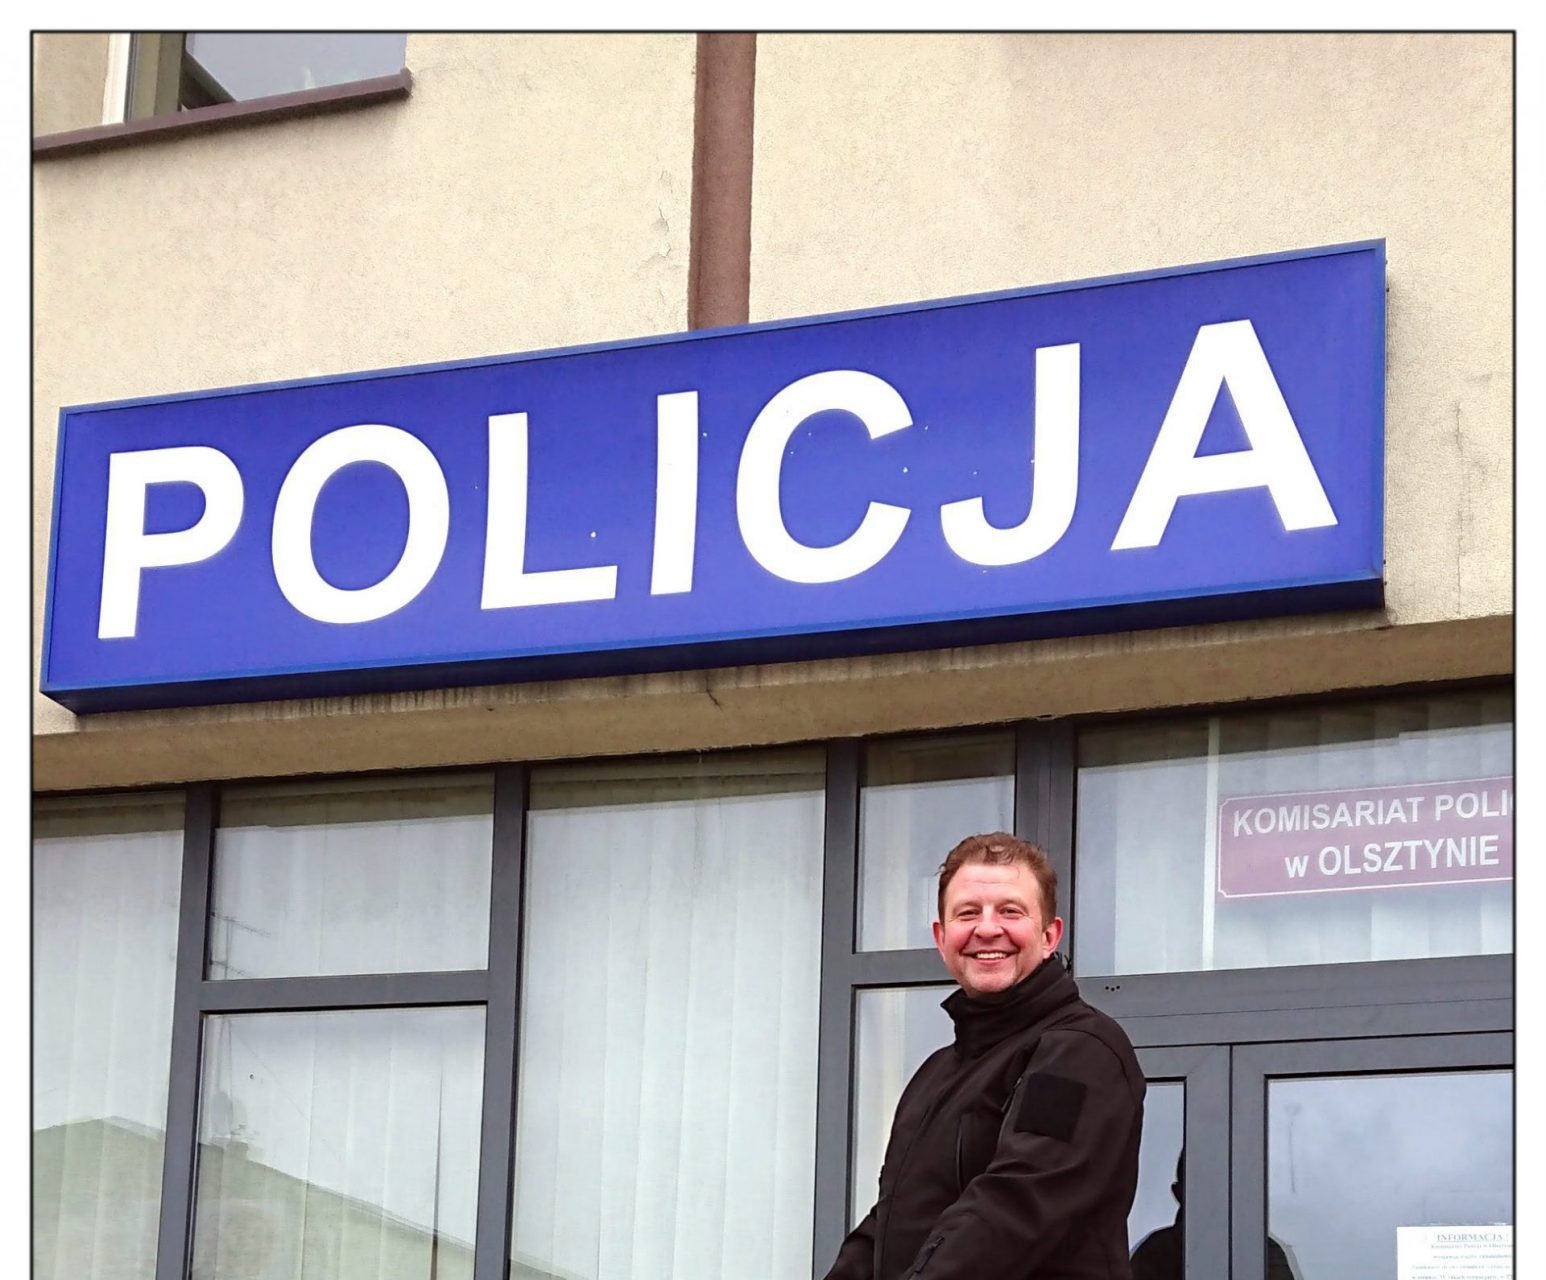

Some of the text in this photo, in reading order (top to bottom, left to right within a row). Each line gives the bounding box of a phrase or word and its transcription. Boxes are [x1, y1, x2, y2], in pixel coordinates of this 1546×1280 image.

[98, 319, 1338, 639] POLICJA
[1233, 788, 1513, 837] KOMISARIAT POLI
[1284, 833, 1500, 879] w OLSZTYNIE
[1437, 1233, 1503, 1241] INFORMACJA
